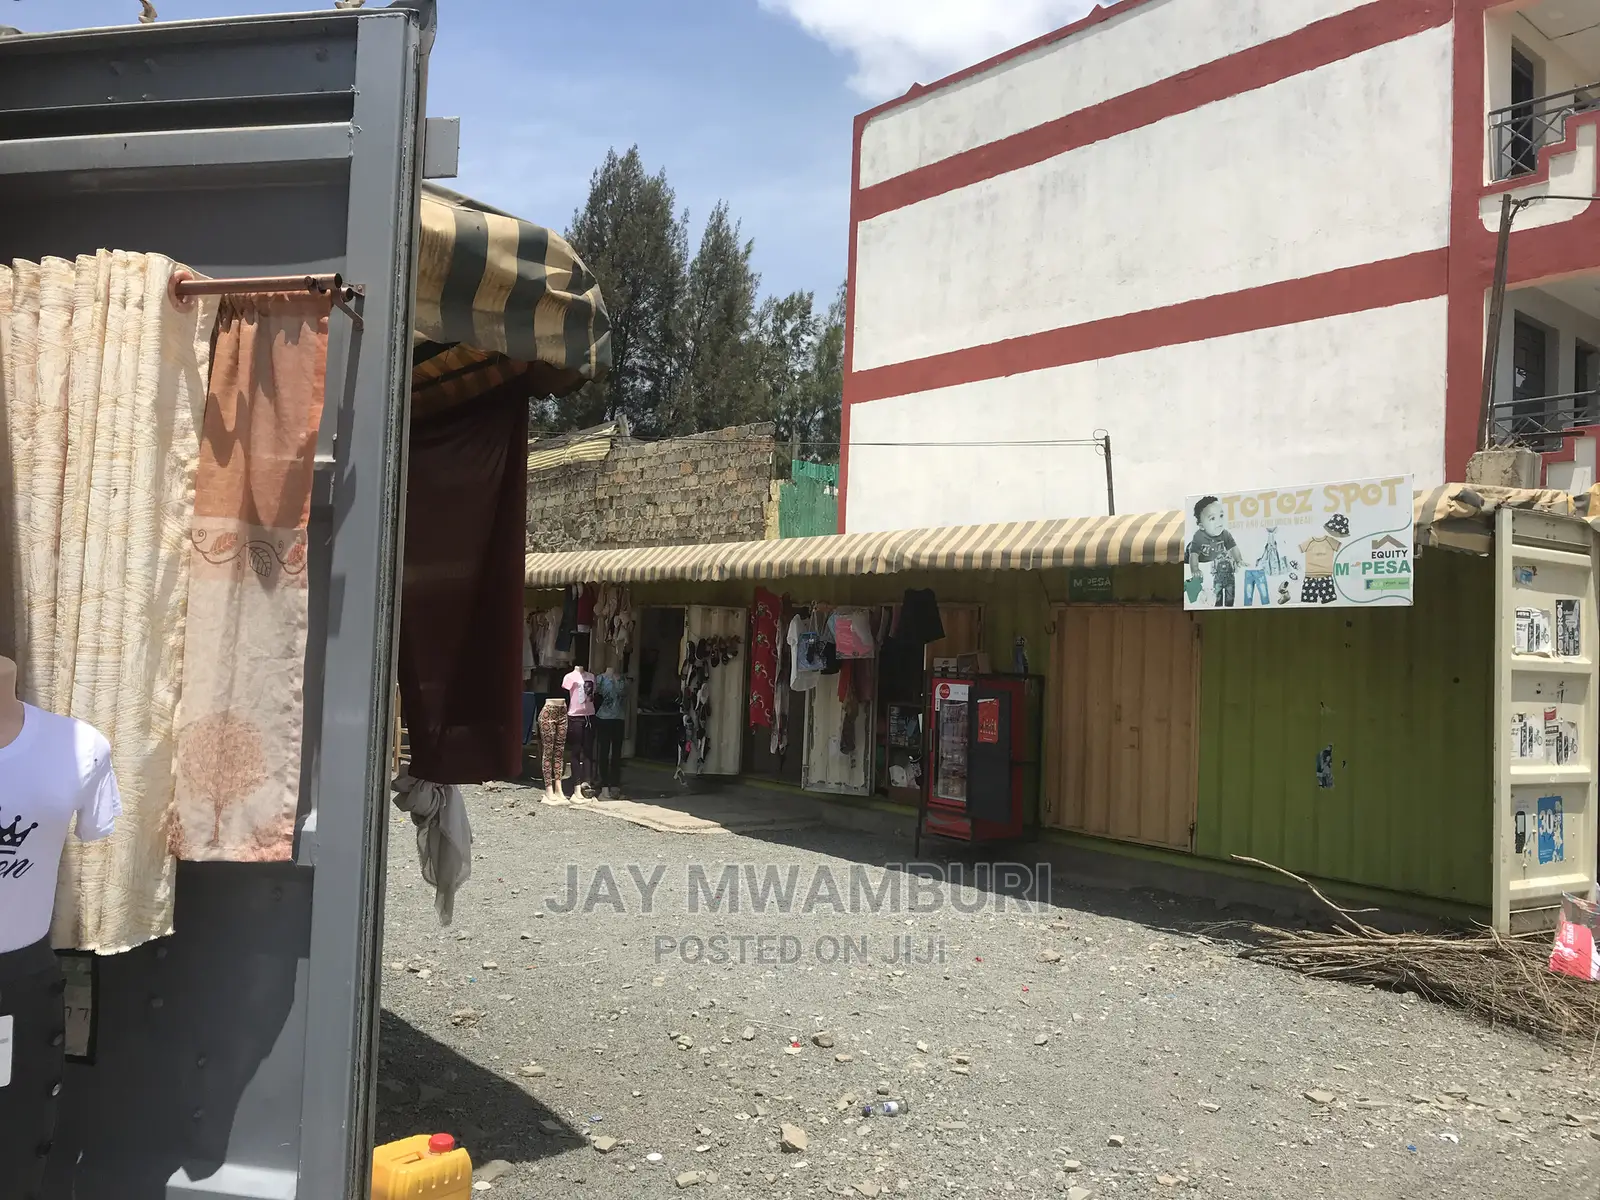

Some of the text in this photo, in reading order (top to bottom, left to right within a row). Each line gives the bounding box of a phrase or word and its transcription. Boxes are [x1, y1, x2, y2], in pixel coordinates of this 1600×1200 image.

[1222, 477, 1405, 521] TOTOZ SPOT
[1371, 549, 1408, 560] EQUITY
[1539, 808, 1554, 835] 30
